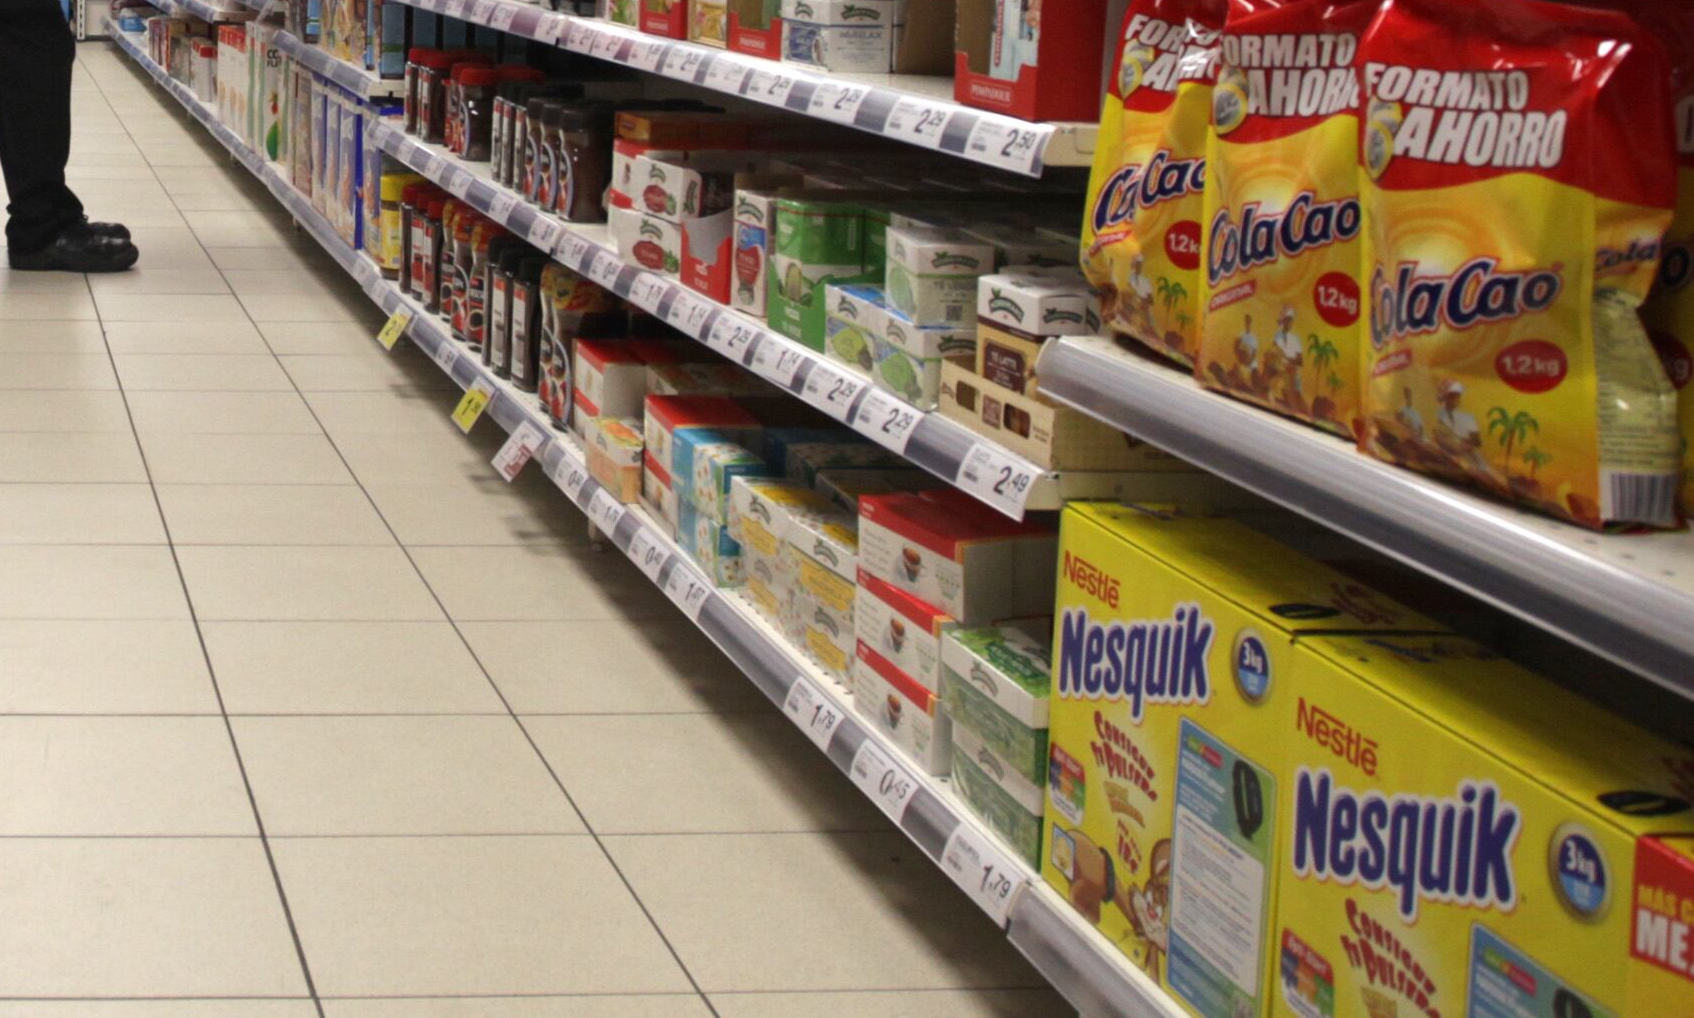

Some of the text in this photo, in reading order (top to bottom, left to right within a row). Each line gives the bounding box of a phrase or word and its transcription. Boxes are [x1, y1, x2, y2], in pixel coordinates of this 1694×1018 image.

[1364, 62, 1529, 111] FORMATO
[1393, 107, 1566, 168] AHORRO
[1058, 604, 1214, 720] Nesquik
[1292, 770, 1517, 917] Nesquik
[1634, 907, 1694, 973] ME
